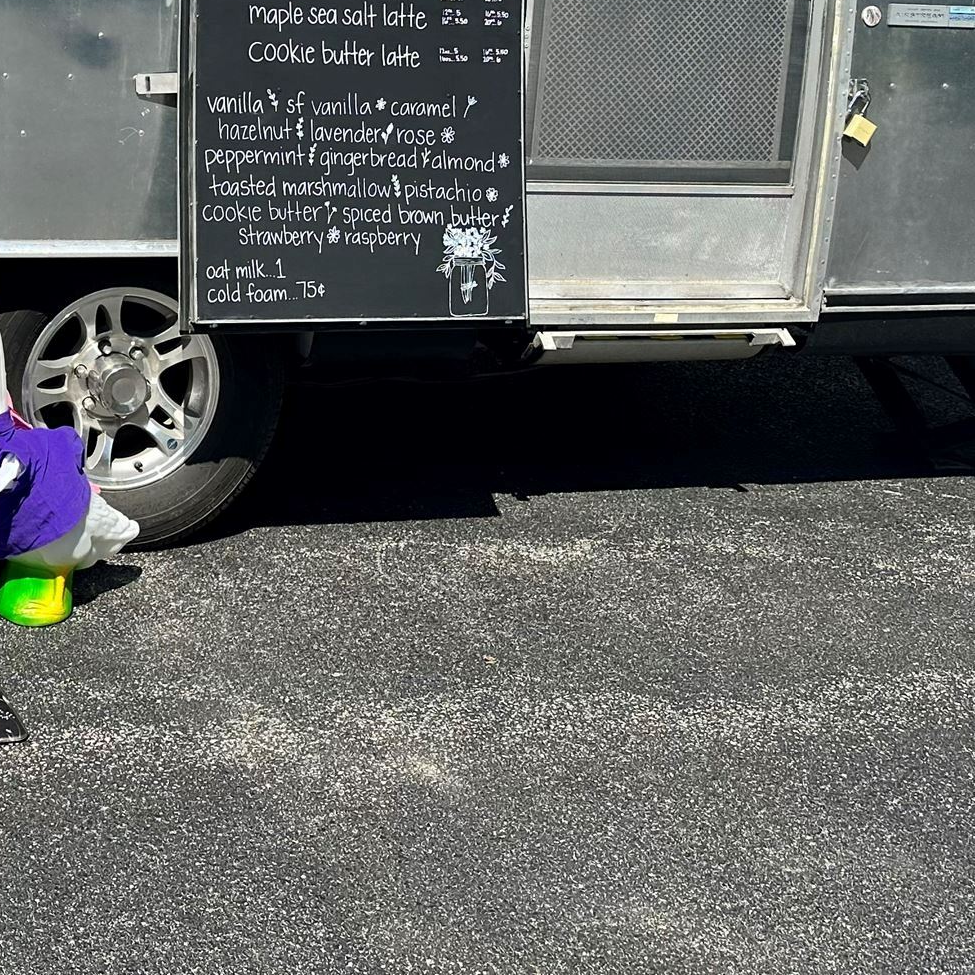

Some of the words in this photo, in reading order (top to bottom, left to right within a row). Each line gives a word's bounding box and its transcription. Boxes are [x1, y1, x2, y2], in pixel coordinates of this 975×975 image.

[249, 1, 304, 32] maple
[307, 6, 338, 25] sea
[341, 3, 377, 27] salt
[382, 2, 427, 30] latte
[321, 40, 375, 66] butter
[381, 44, 421, 68] latte
[206, 91, 264, 114] vanilla
[286, 90, 305, 114] sf
[311, 92, 372, 116] vanilla
[390, 94, 457, 119] caramel
[217, 117, 293, 142] hazelnut
[310, 120, 382, 144] lavender
[396, 126, 436, 145] rose
[204, 143, 306, 173] peppermint
[320, 146, 417, 177] gingerbread
[431, 151, 496, 173] almond
[209, 173, 276, 198] toasted
[282, 174, 392, 199] marshmallow
[405, 177, 482, 205] pistachio
[202, 199, 262, 222] cookie
[269, 198, 323, 223] butter
[343, 203, 392, 231] spiced
[399, 202, 444, 225] brown
[451, 204, 500, 227] butter
[344, 227, 421, 256] raspberry
[206, 259, 229, 280] oat
[206, 278, 241, 304] cold
